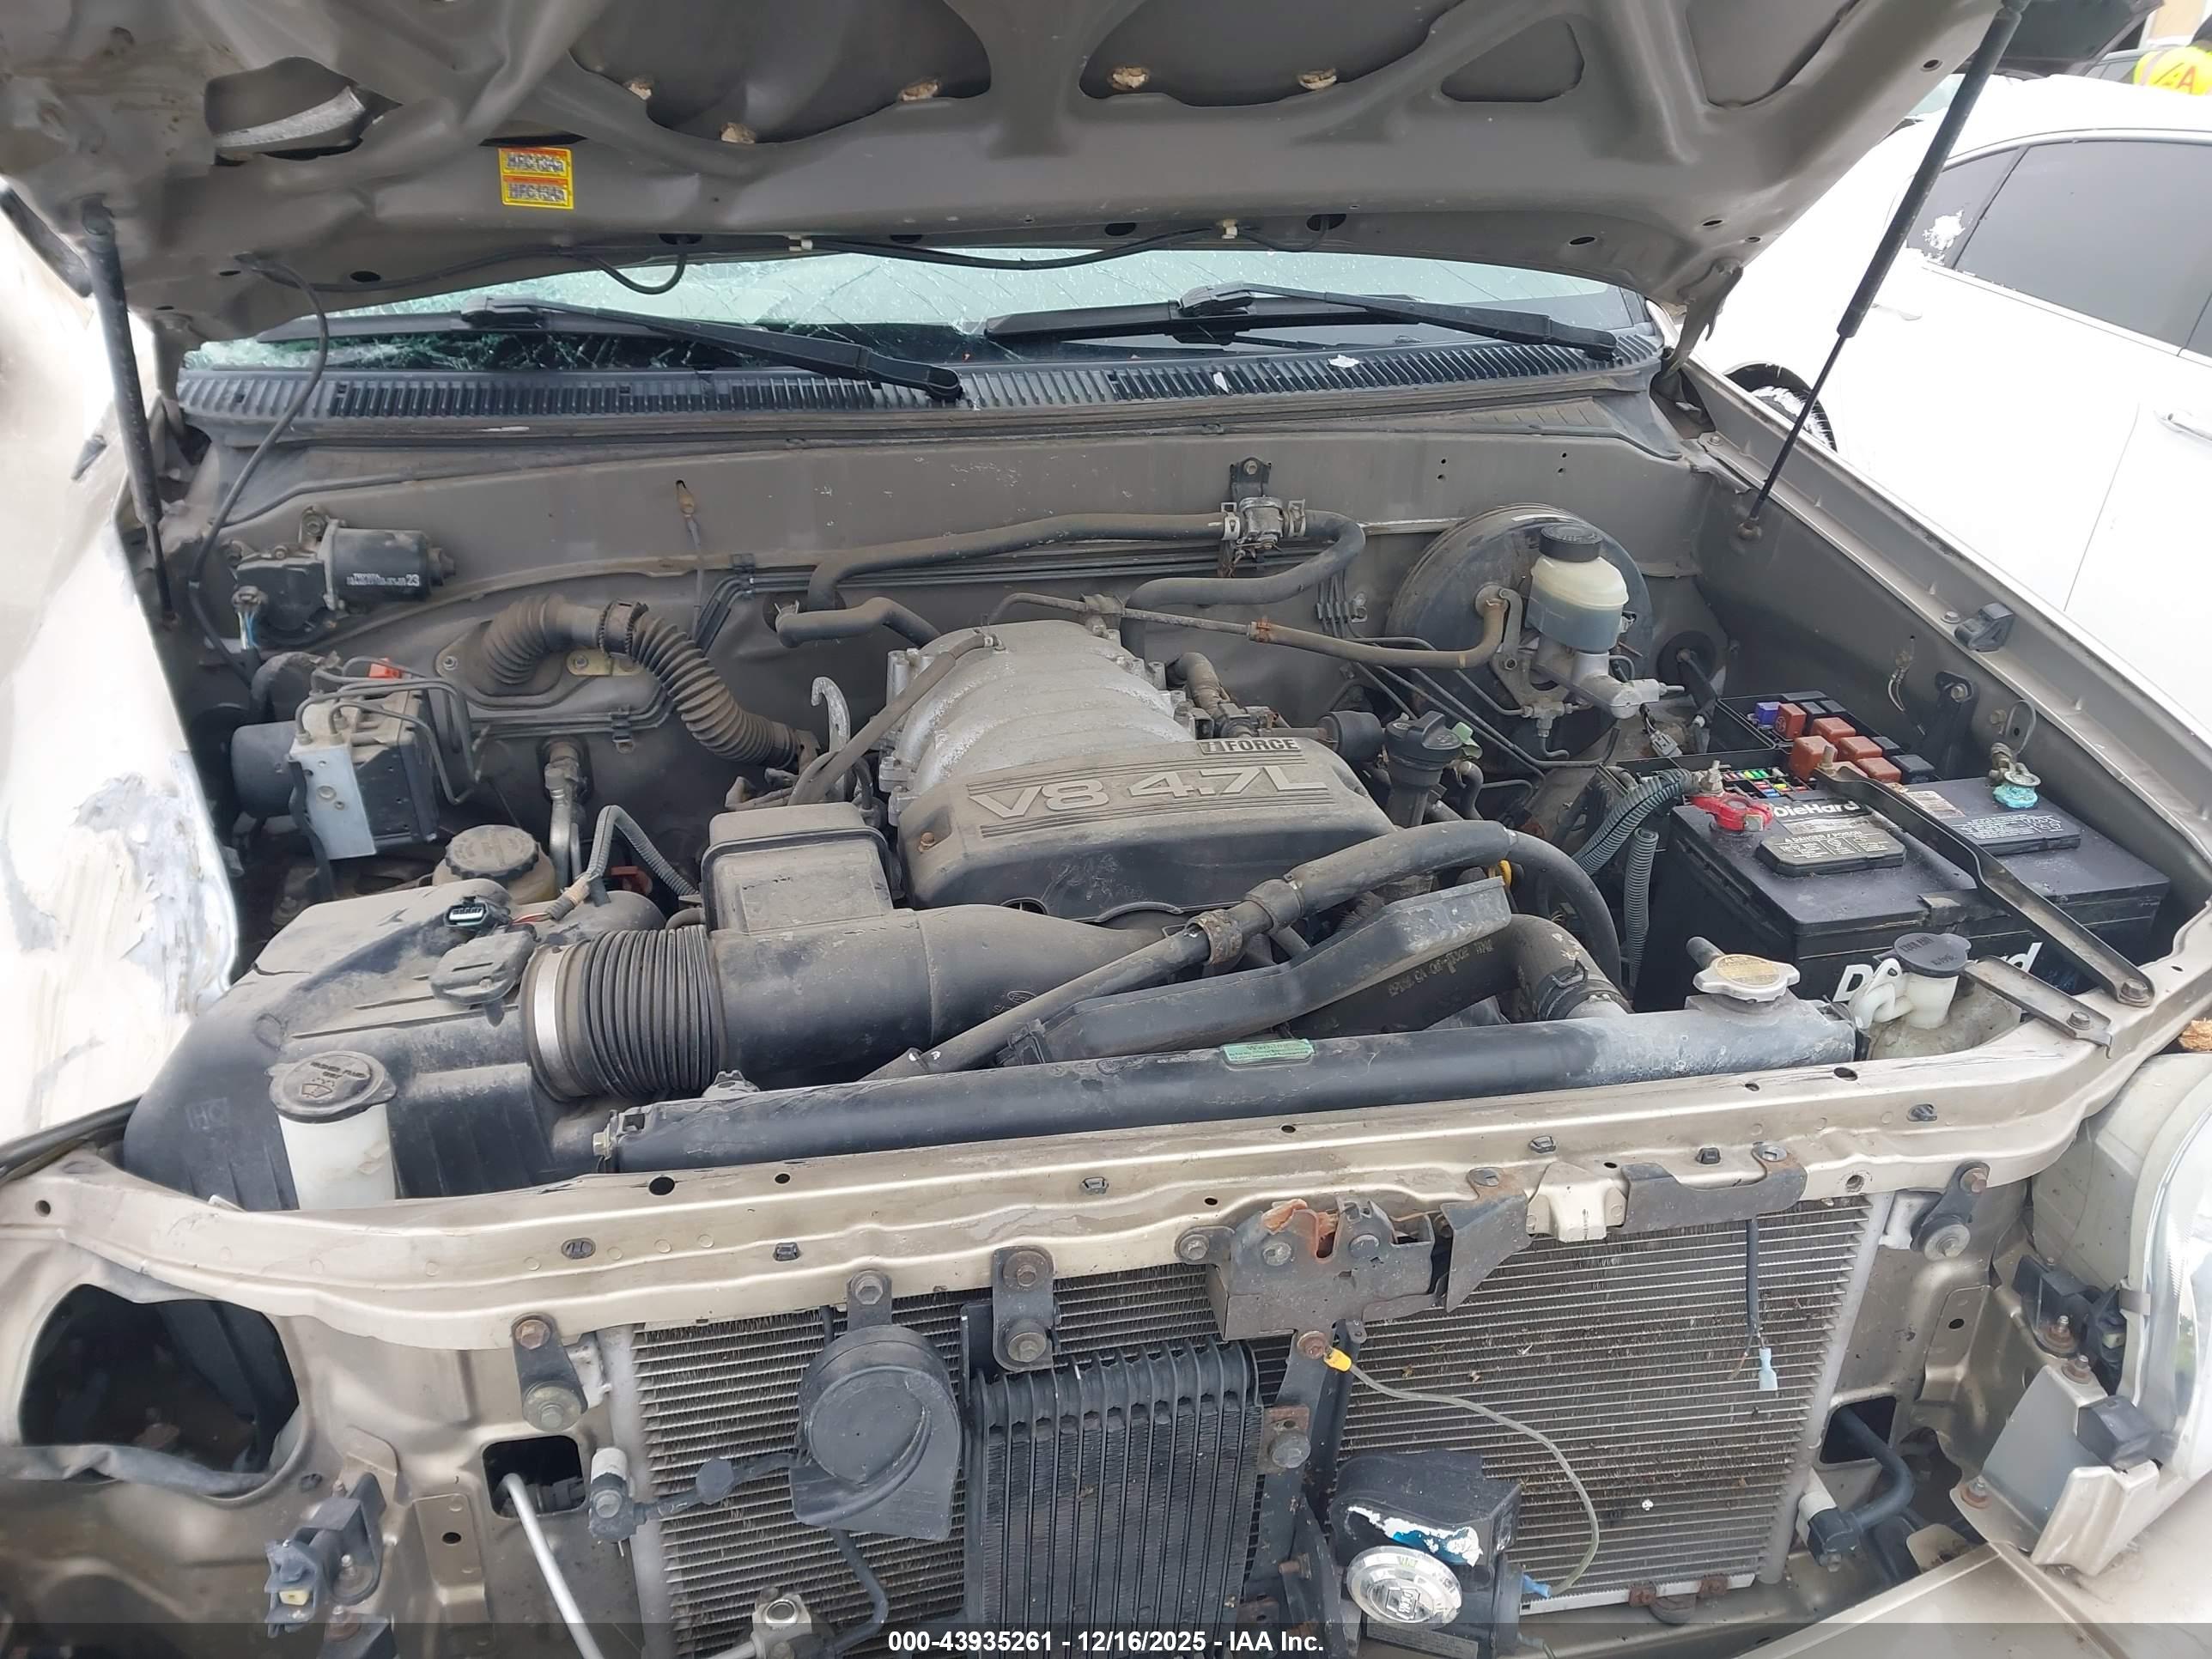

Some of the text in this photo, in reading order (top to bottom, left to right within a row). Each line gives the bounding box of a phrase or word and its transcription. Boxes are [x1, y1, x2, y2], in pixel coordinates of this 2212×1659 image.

[969, 764, 1330, 818] V8 4.7L
[1773, 800, 1861, 817] DieHard
